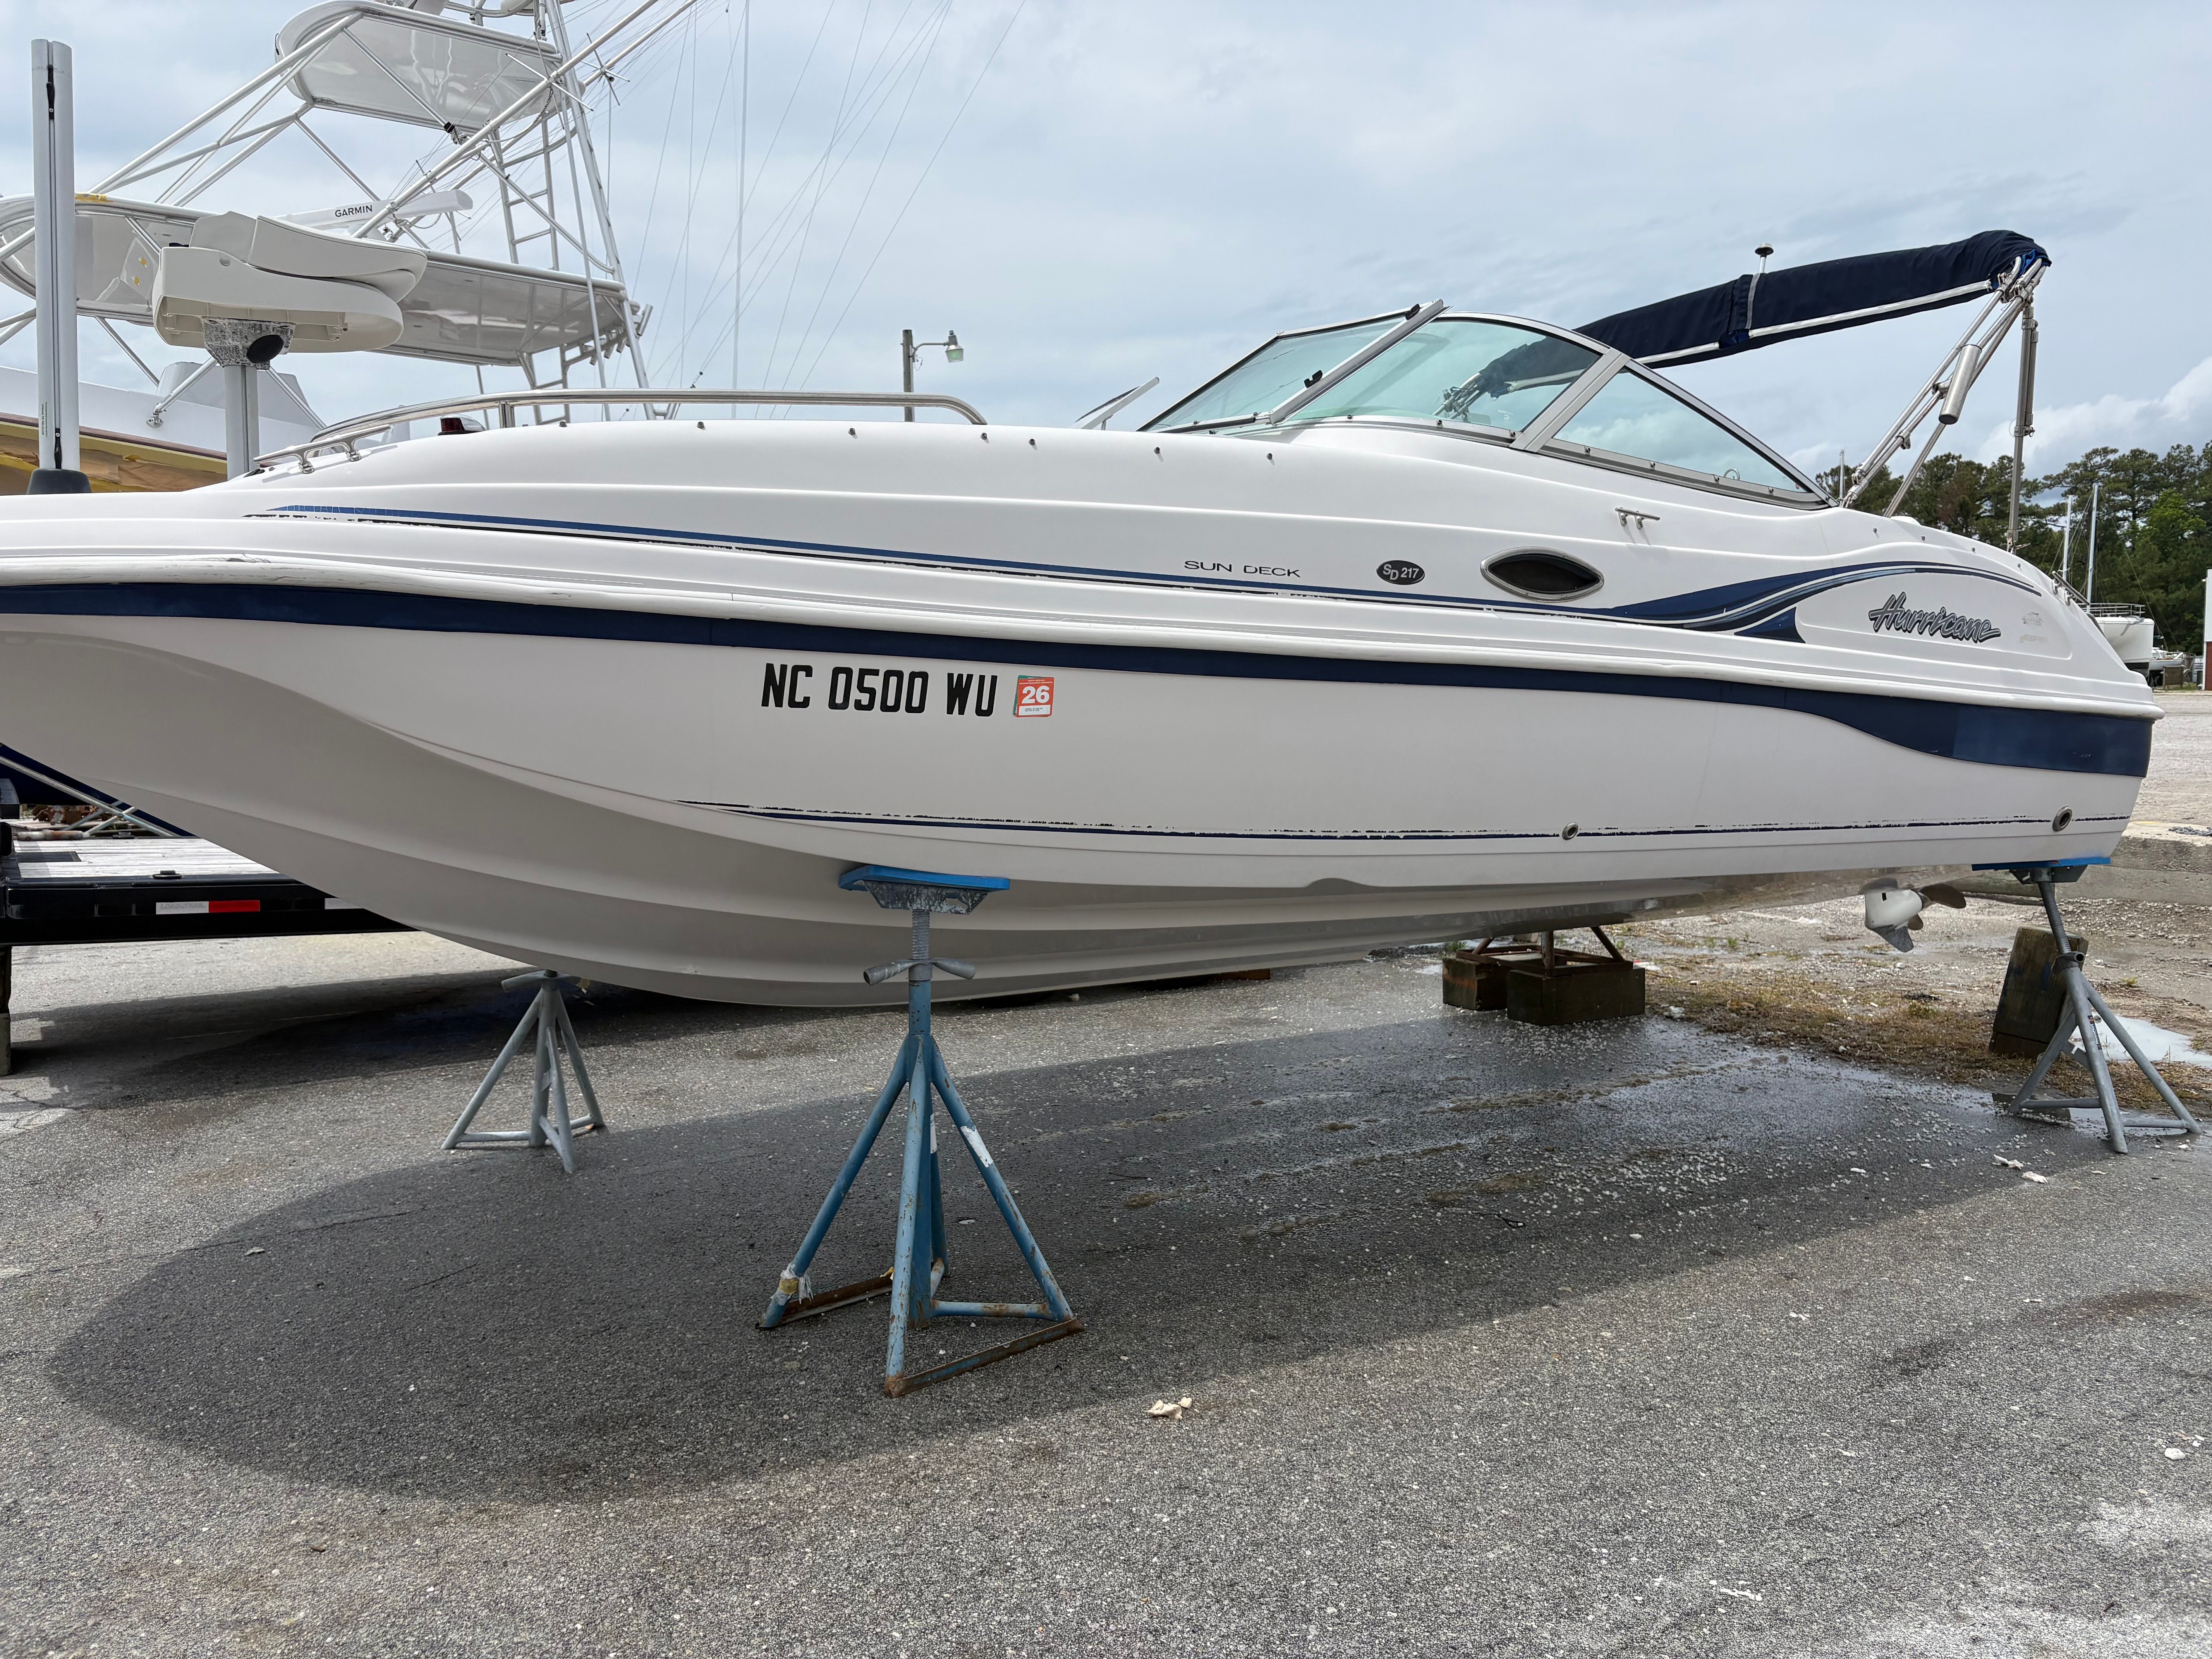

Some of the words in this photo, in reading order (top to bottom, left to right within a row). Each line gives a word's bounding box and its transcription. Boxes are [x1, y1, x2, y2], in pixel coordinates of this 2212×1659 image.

[335, 205, 373, 217] GARMIN
[1184, 561, 1232, 572] SUN
[1243, 565, 1301, 578] DECK
[1383, 564, 1399, 580] SD
[1400, 567, 1419, 578] 217
[1868, 591, 2001, 644] Hurricane
[761, 663, 813, 708] NC
[828, 666, 929, 714] 0500
[946, 673, 998, 717] WU
[1021, 685, 1050, 704] 26
